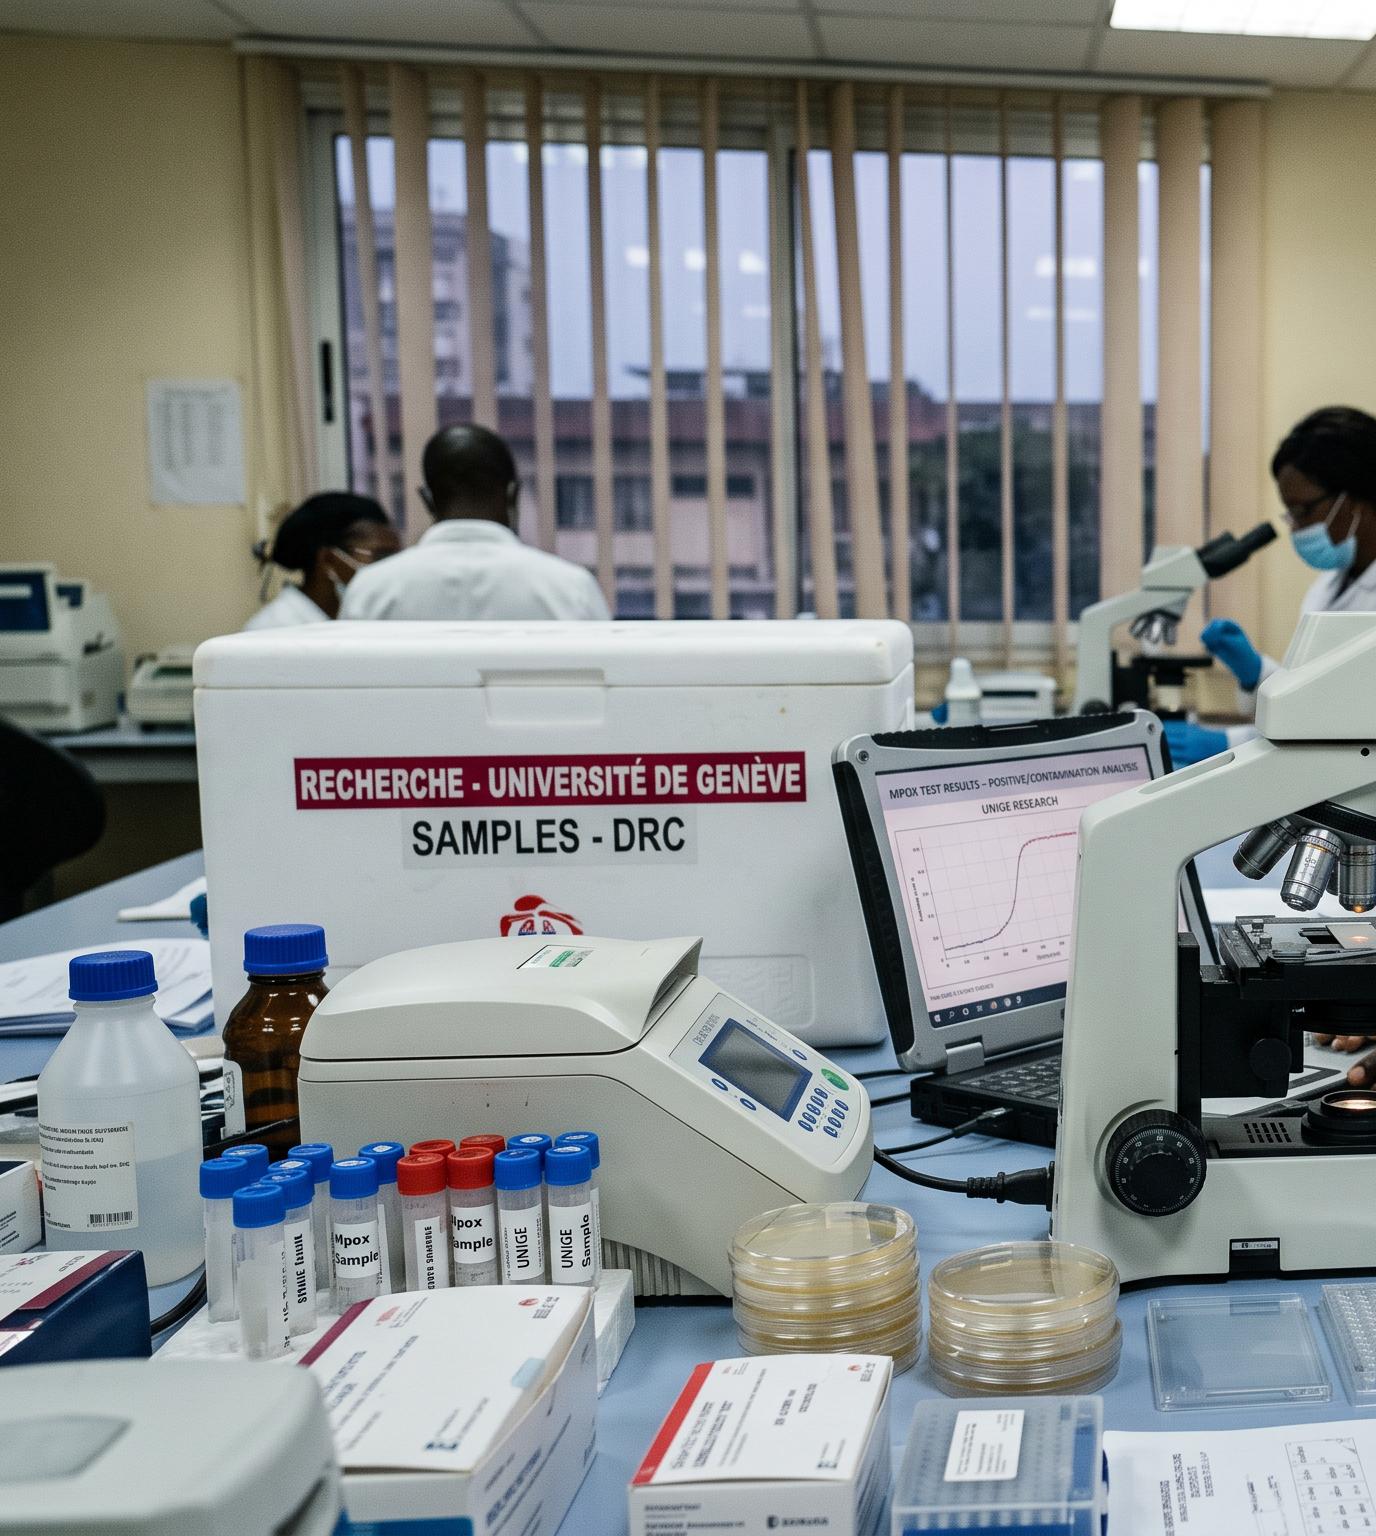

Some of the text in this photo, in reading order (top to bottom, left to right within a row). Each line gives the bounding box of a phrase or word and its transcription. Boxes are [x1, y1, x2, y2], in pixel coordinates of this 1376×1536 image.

[300, 768, 463, 800] RECHERCHE
[488, 758, 647, 798] UNIVERSITÉ
[654, 764, 688, 795] DE
[696, 756, 801, 795] GENÈVE
[889, 786, 919, 800] MPOX
[920, 784, 942, 796] TEST
[944, 780, 980, 793] RESULTS
[988, 766, 1100, 788] POSITIVE/CONTAMINATION
[1102, 762, 1138, 775] ANALYSIS
[981, 796, 1059, 815] UNIGE RESEARCH
[412, 818, 580, 857] SAMPLES
[613, 816, 685, 853] DRC
[335, 1234, 370, 1248] Mpox
[335, 1251, 379, 1267] Sample
[453, 1236, 493, 1252] ample
[514, 1227, 530, 1268] UNIGE
[560, 1229, 574, 1268] UNIGE
